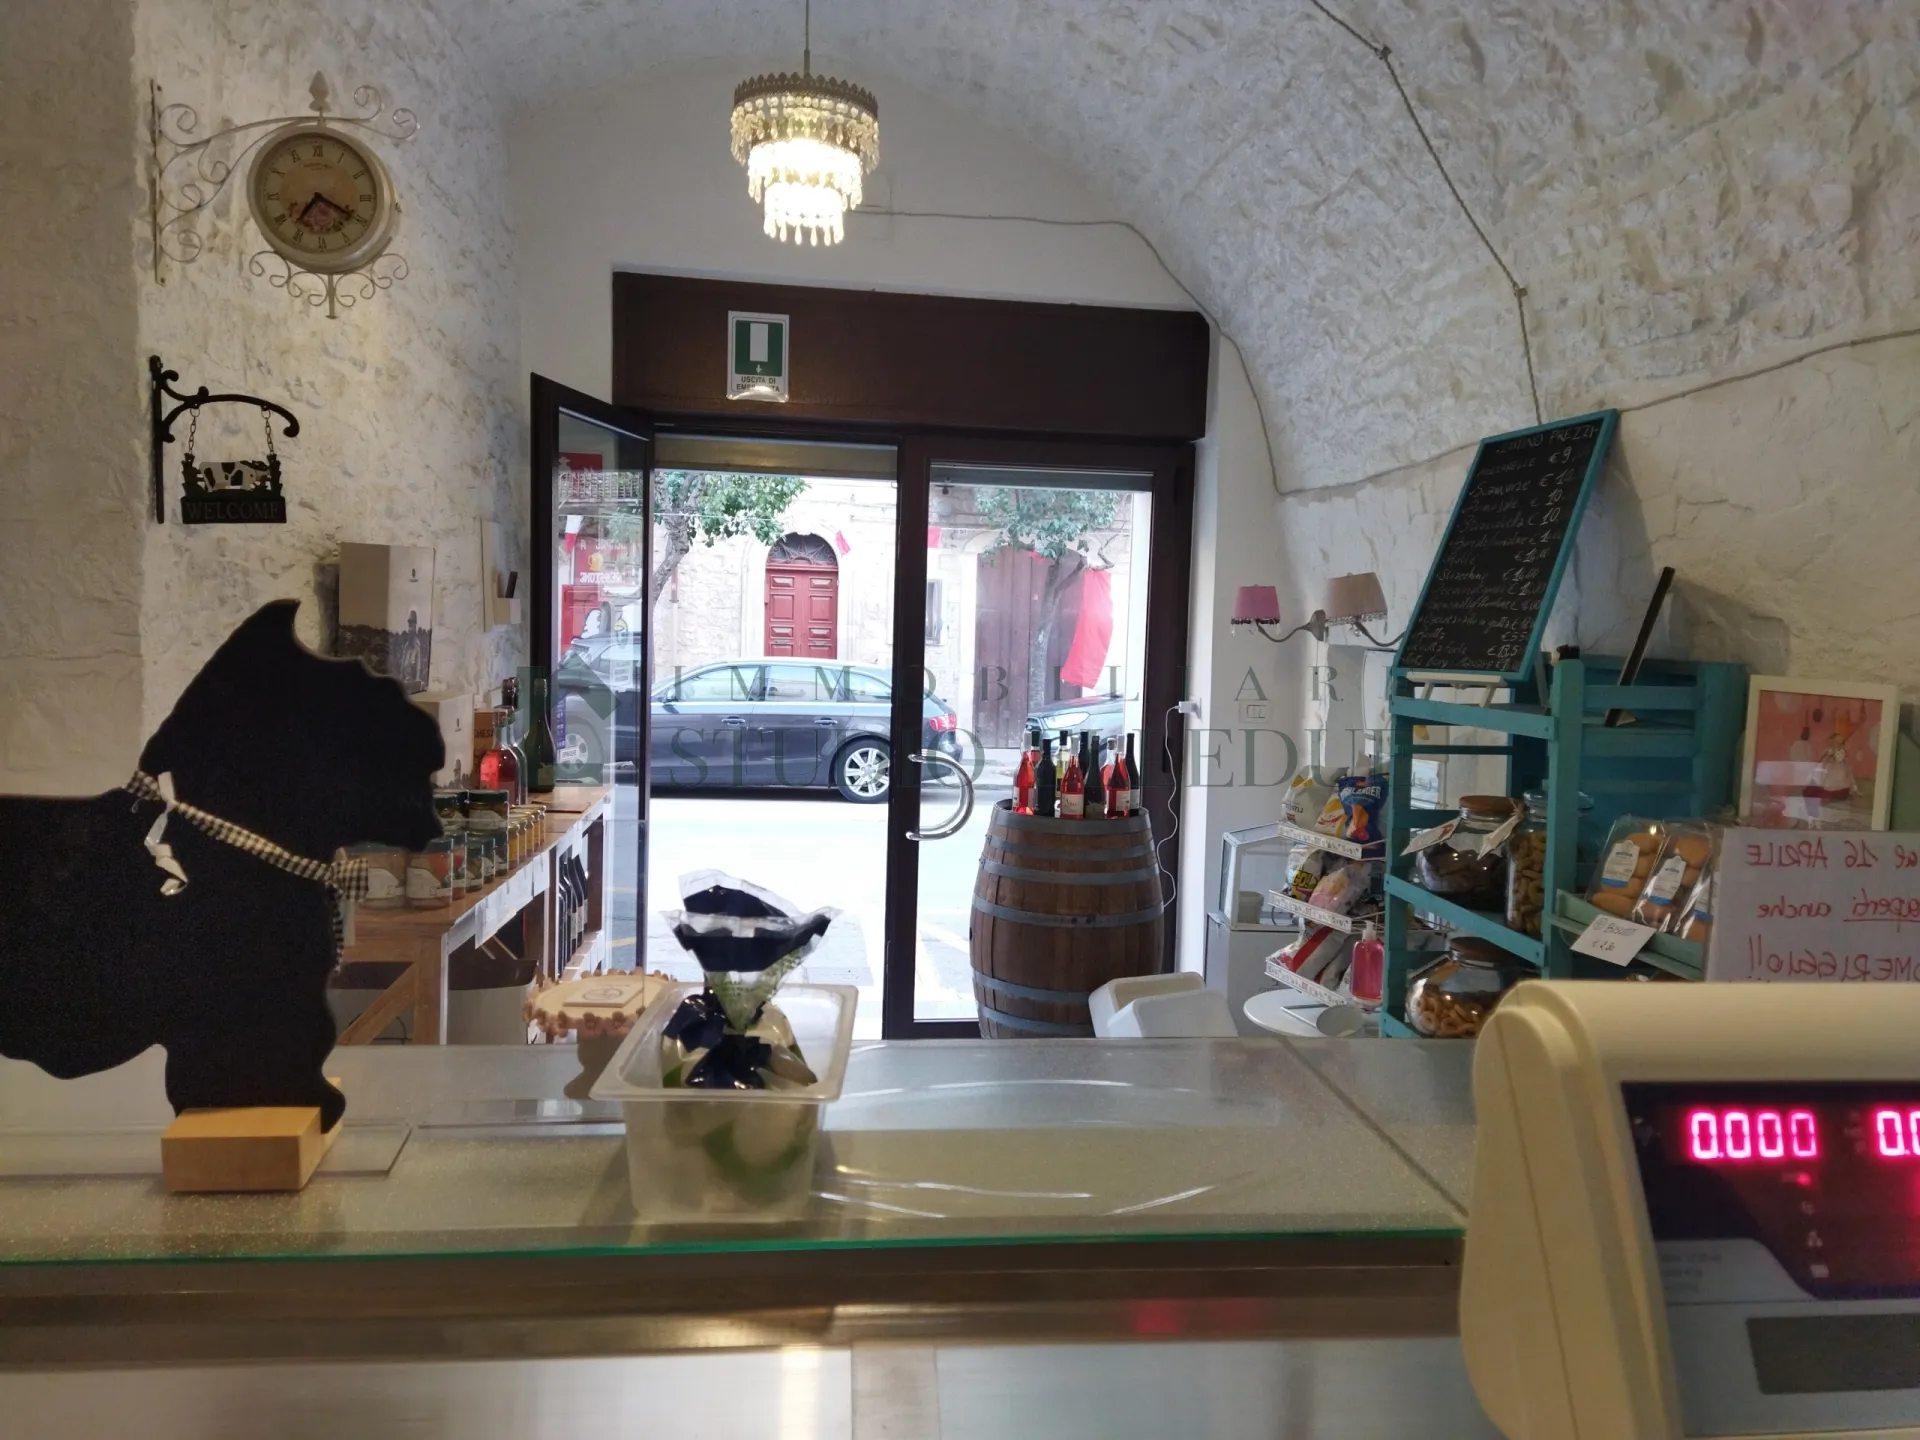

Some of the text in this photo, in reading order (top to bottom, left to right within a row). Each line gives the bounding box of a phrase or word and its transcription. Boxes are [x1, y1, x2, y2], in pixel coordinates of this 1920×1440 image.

[313, 145, 324, 157] XII
[359, 194, 371, 202] III
[741, 376, 765, 384] USCITA
[186, 501, 281, 519] WELCOME
[1293, 870, 1312, 888] GO!
[1689, 1111, 1818, 1160] 0.000
